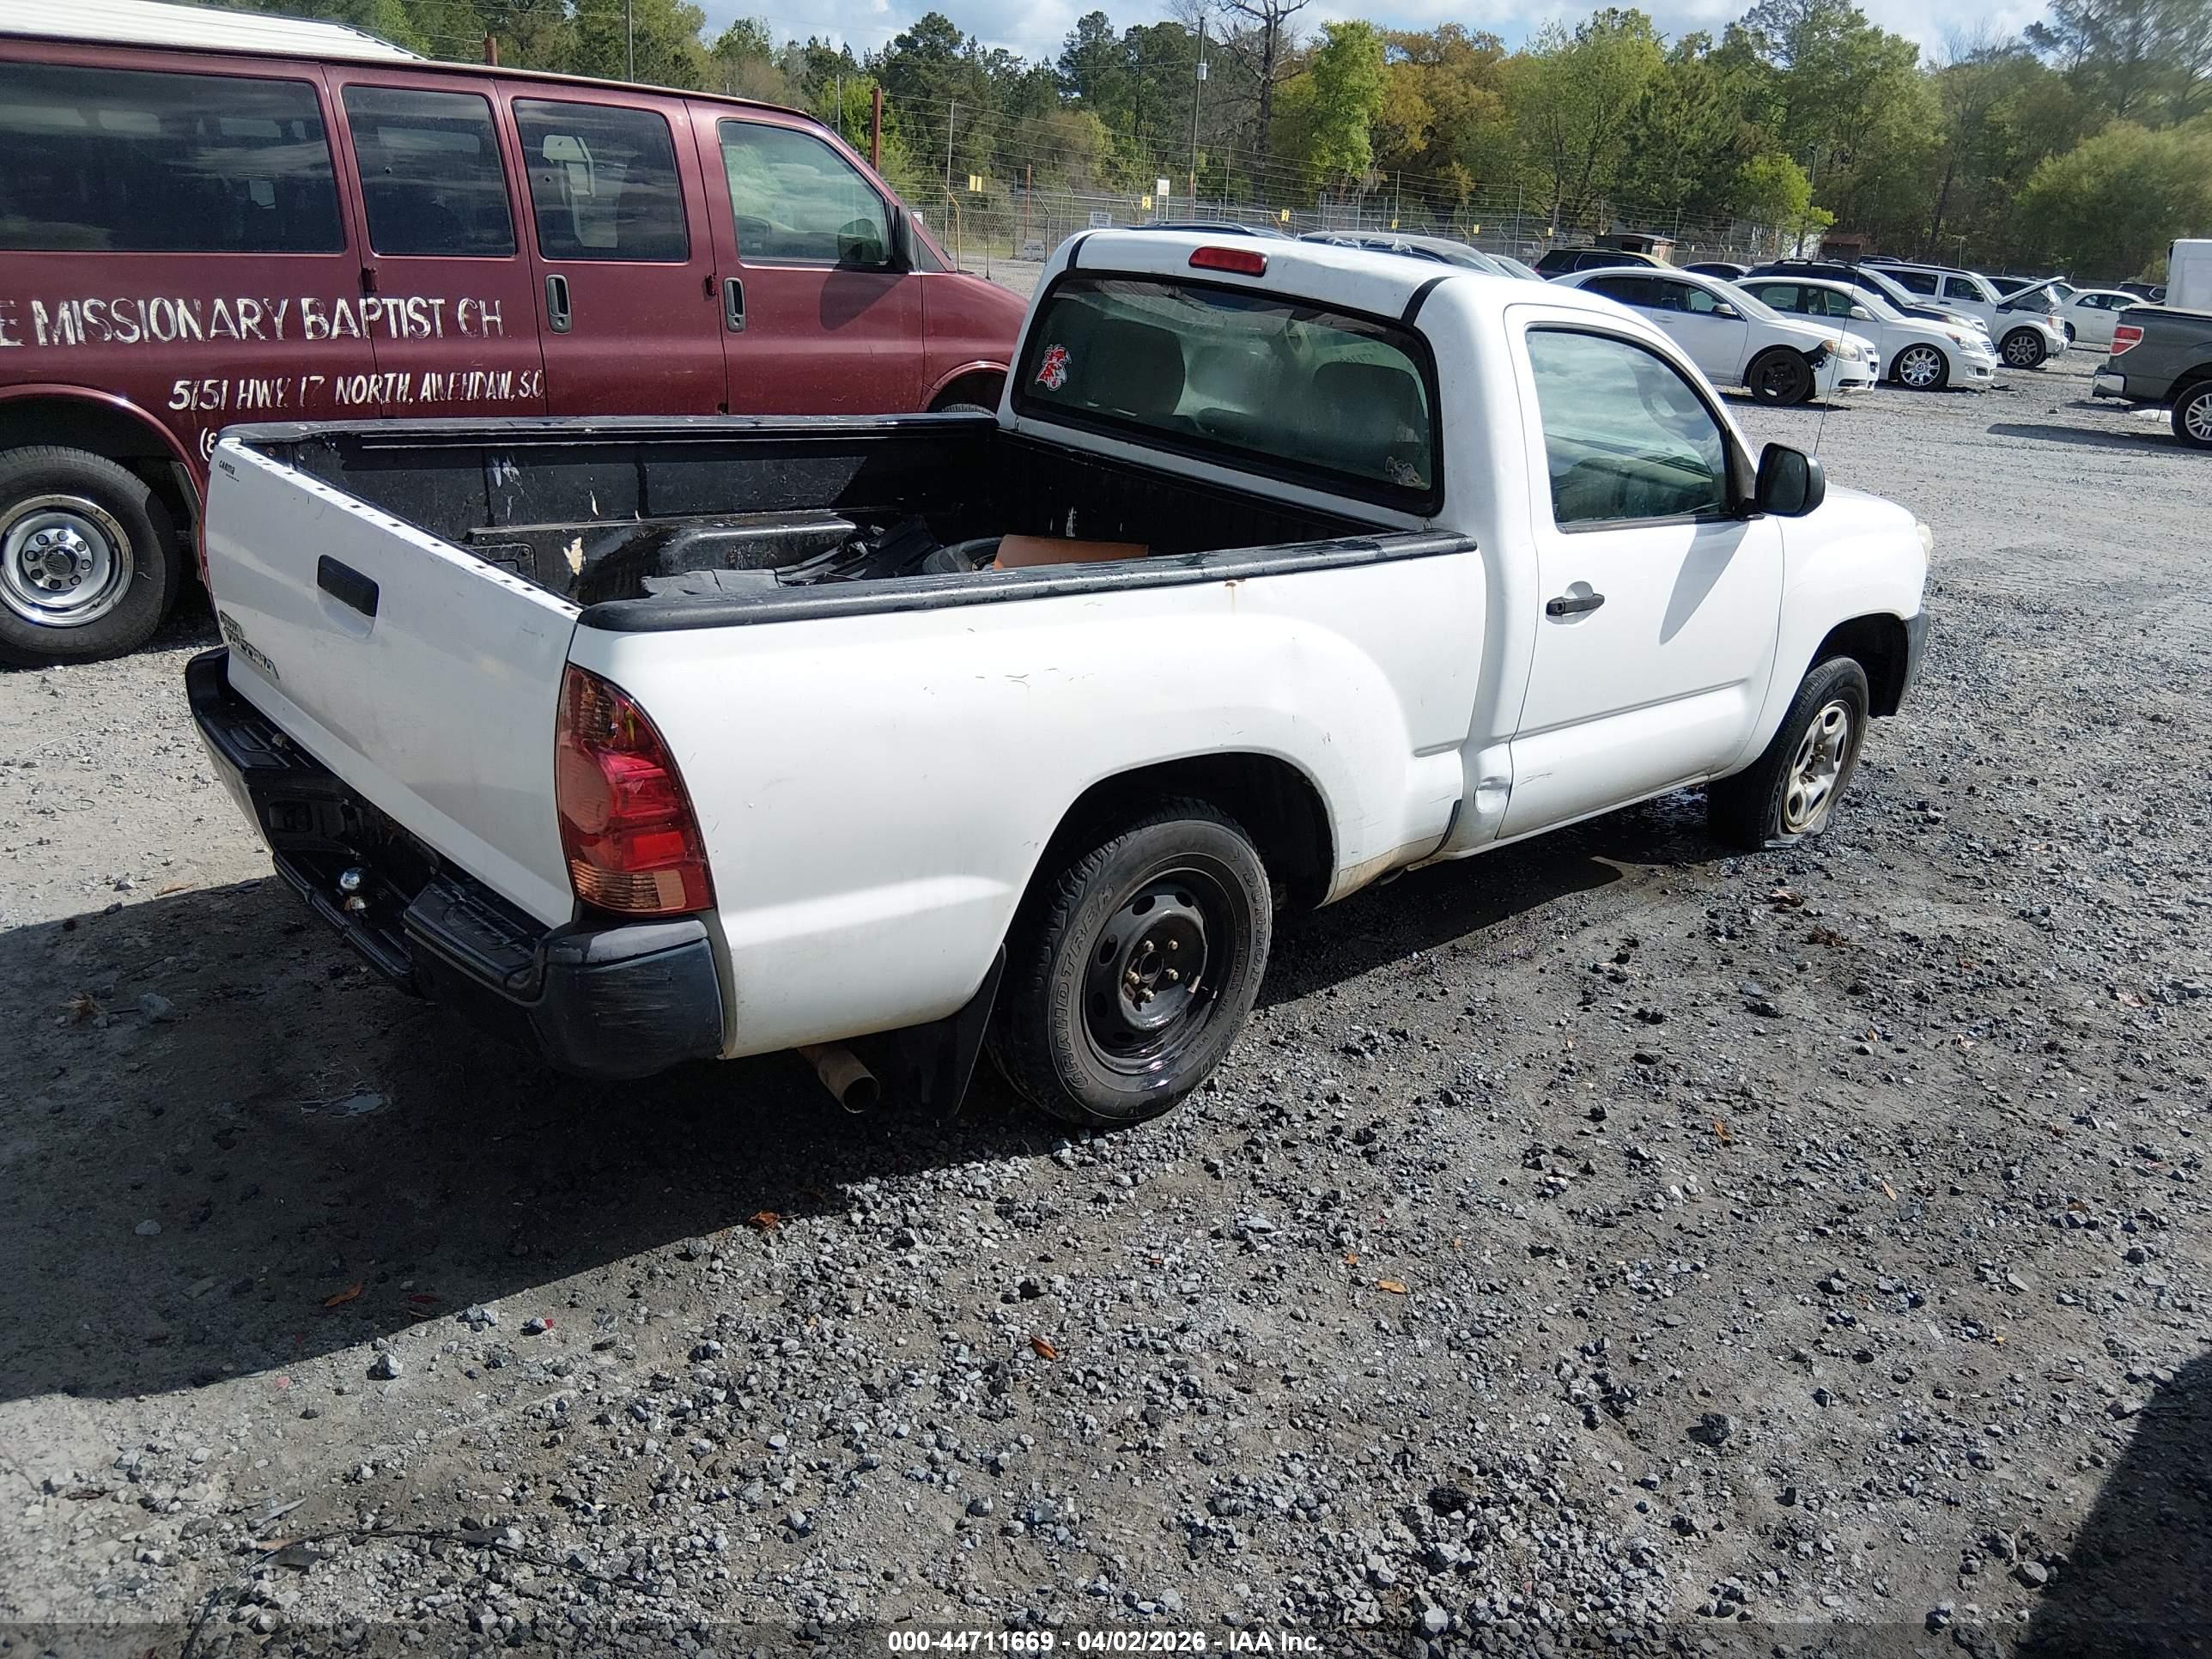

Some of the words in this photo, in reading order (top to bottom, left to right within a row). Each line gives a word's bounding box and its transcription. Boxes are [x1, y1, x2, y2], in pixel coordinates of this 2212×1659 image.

[31, 297, 289, 345] MISSIONARY
[301, 296, 445, 340] BAPTIST
[168, 380, 228, 410] 5151
[335, 373, 414, 405] NORTH,
